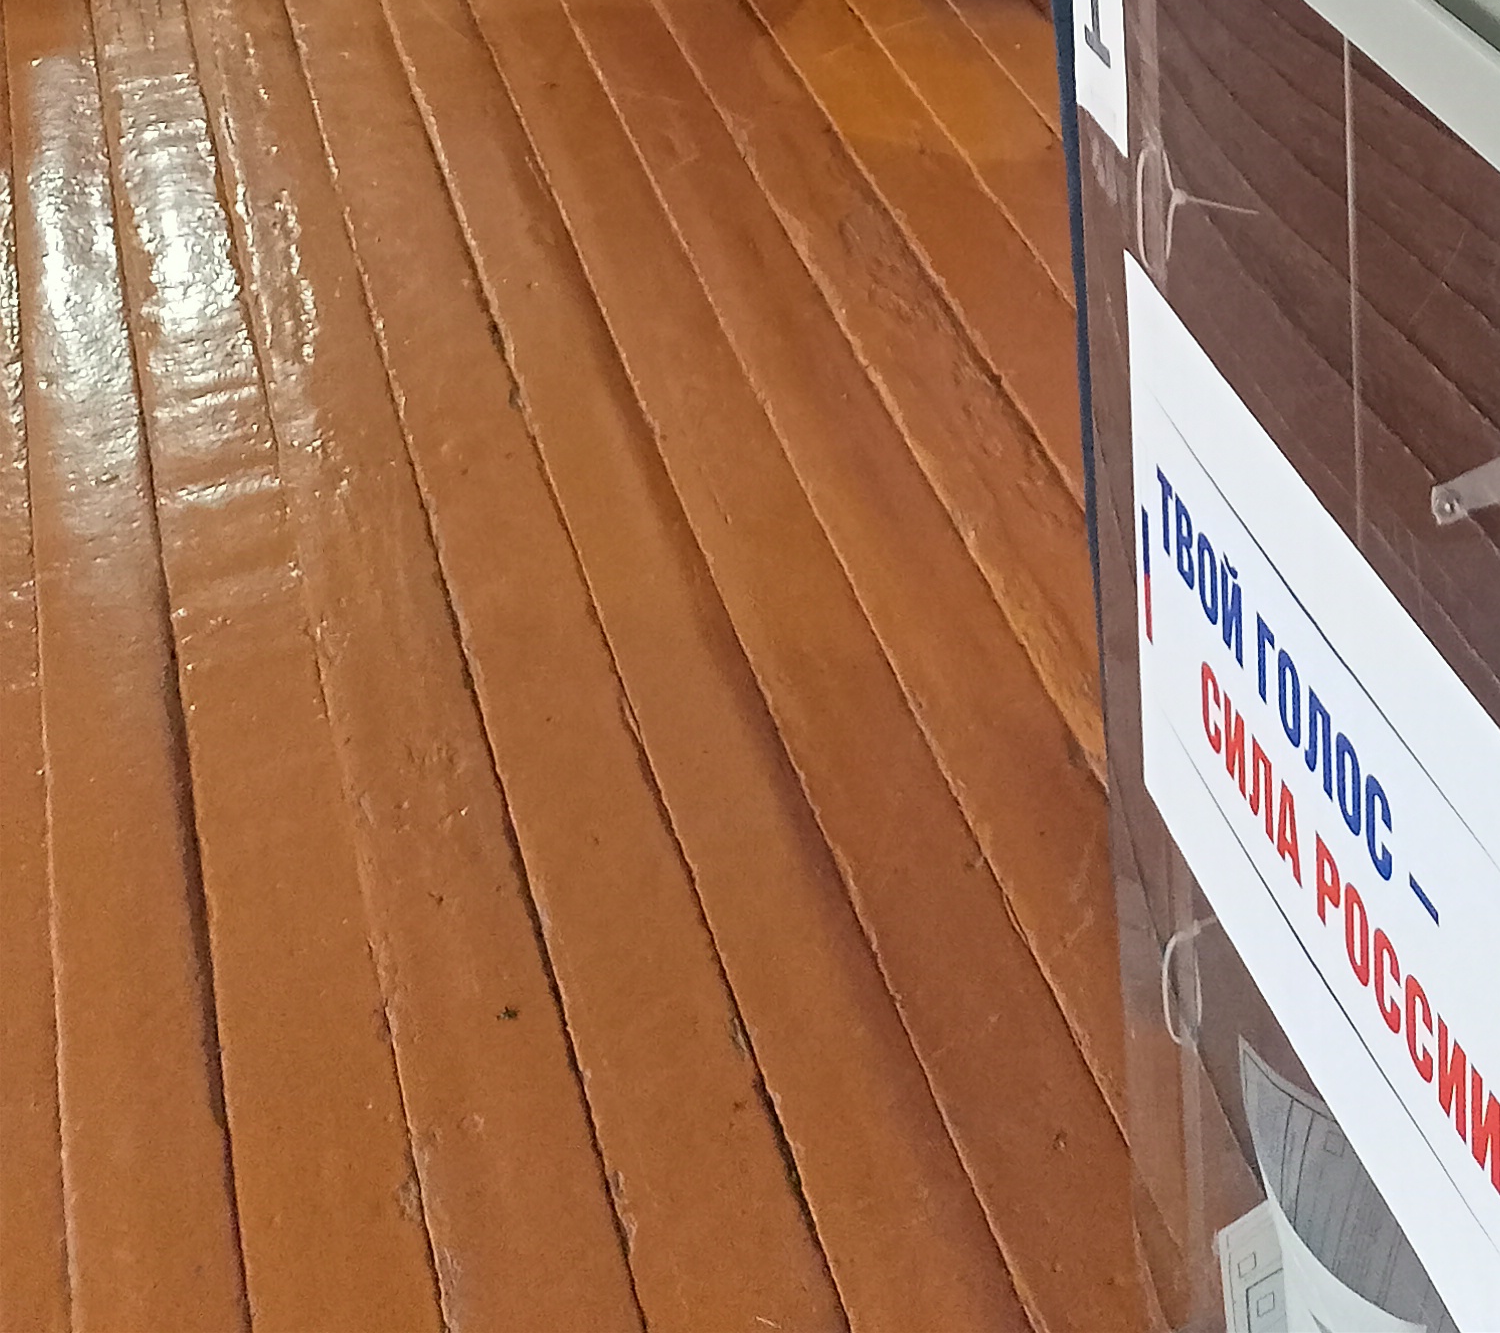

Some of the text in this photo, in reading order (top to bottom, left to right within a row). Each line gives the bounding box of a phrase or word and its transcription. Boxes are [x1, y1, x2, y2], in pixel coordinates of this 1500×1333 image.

[1156, 463, 1243, 668] ТВОЙ
[1257, 614, 1393, 881] ГОЛОС
[1201, 663, 1302, 887] СИЛА
